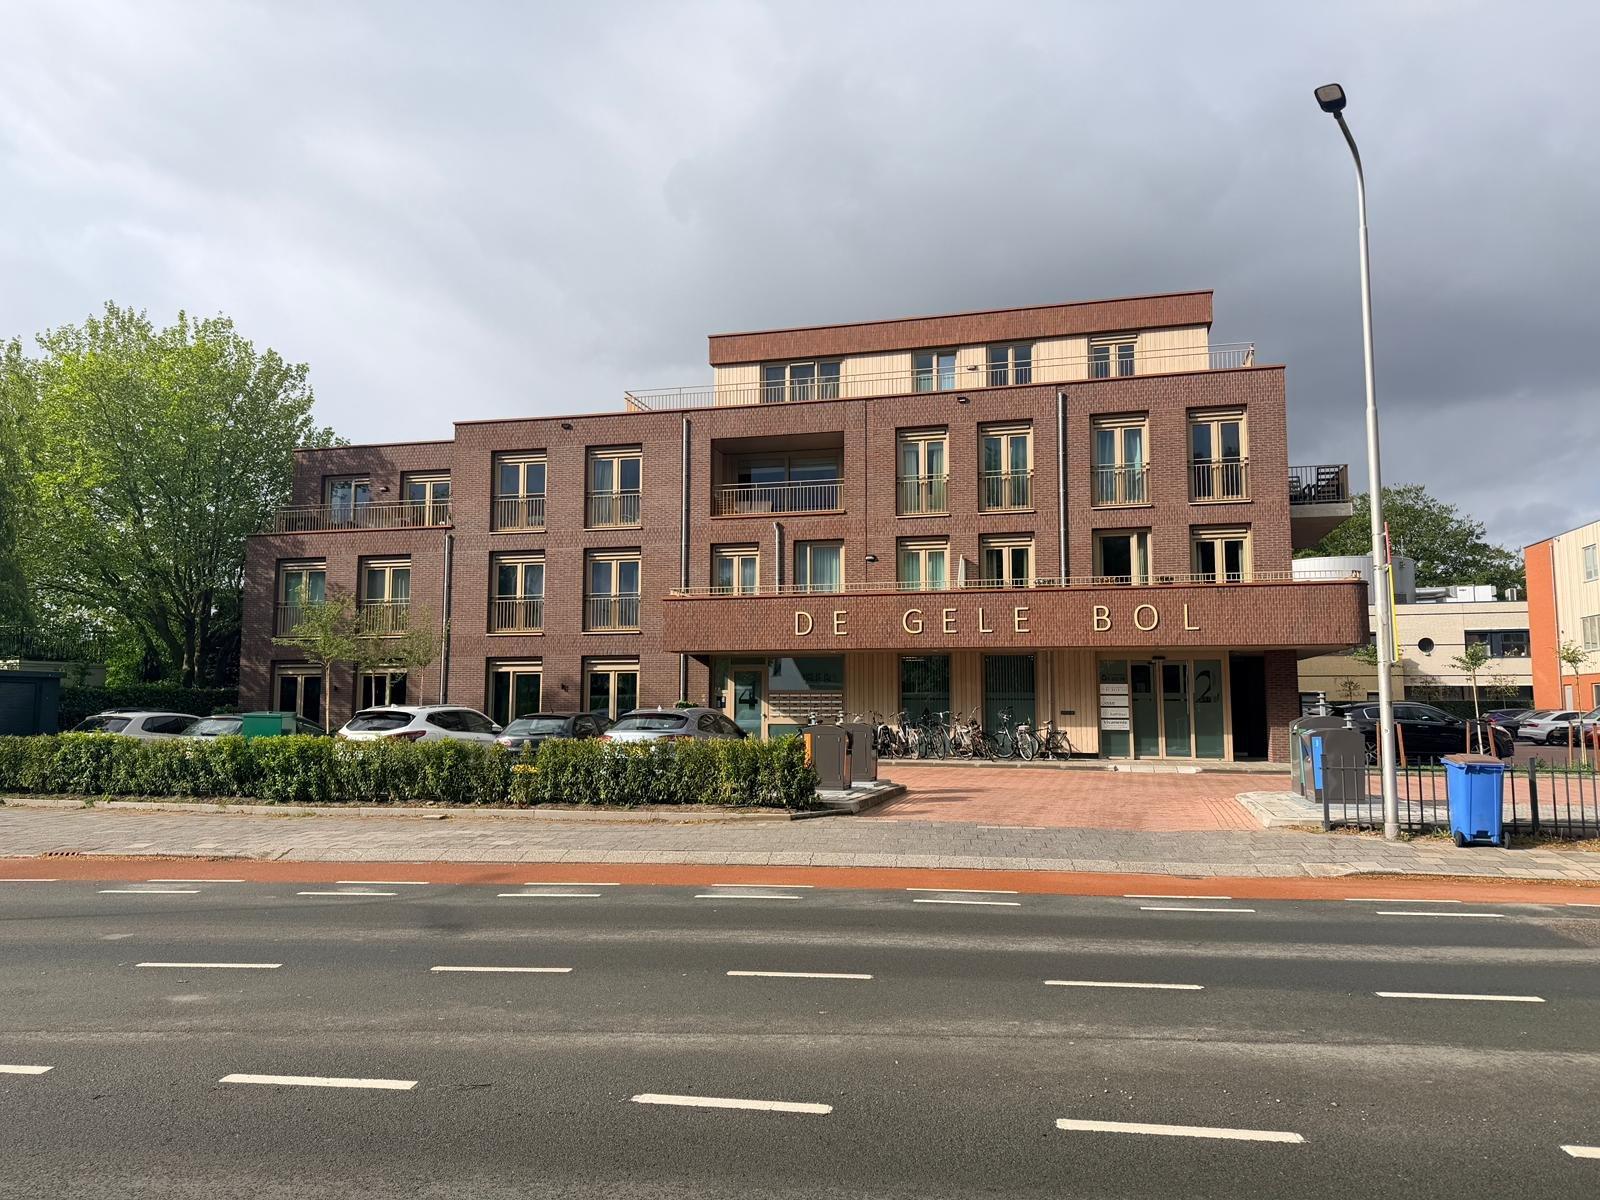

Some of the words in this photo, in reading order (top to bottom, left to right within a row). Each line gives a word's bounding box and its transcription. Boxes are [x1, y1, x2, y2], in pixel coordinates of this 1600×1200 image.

[794, 610, 848, 636] DE
[902, 607, 1031, 635] GELE
[1093, 604, 1201, 632] BOL
[738, 680, 758, 710] 4
[1195, 670, 1212, 703] 2
